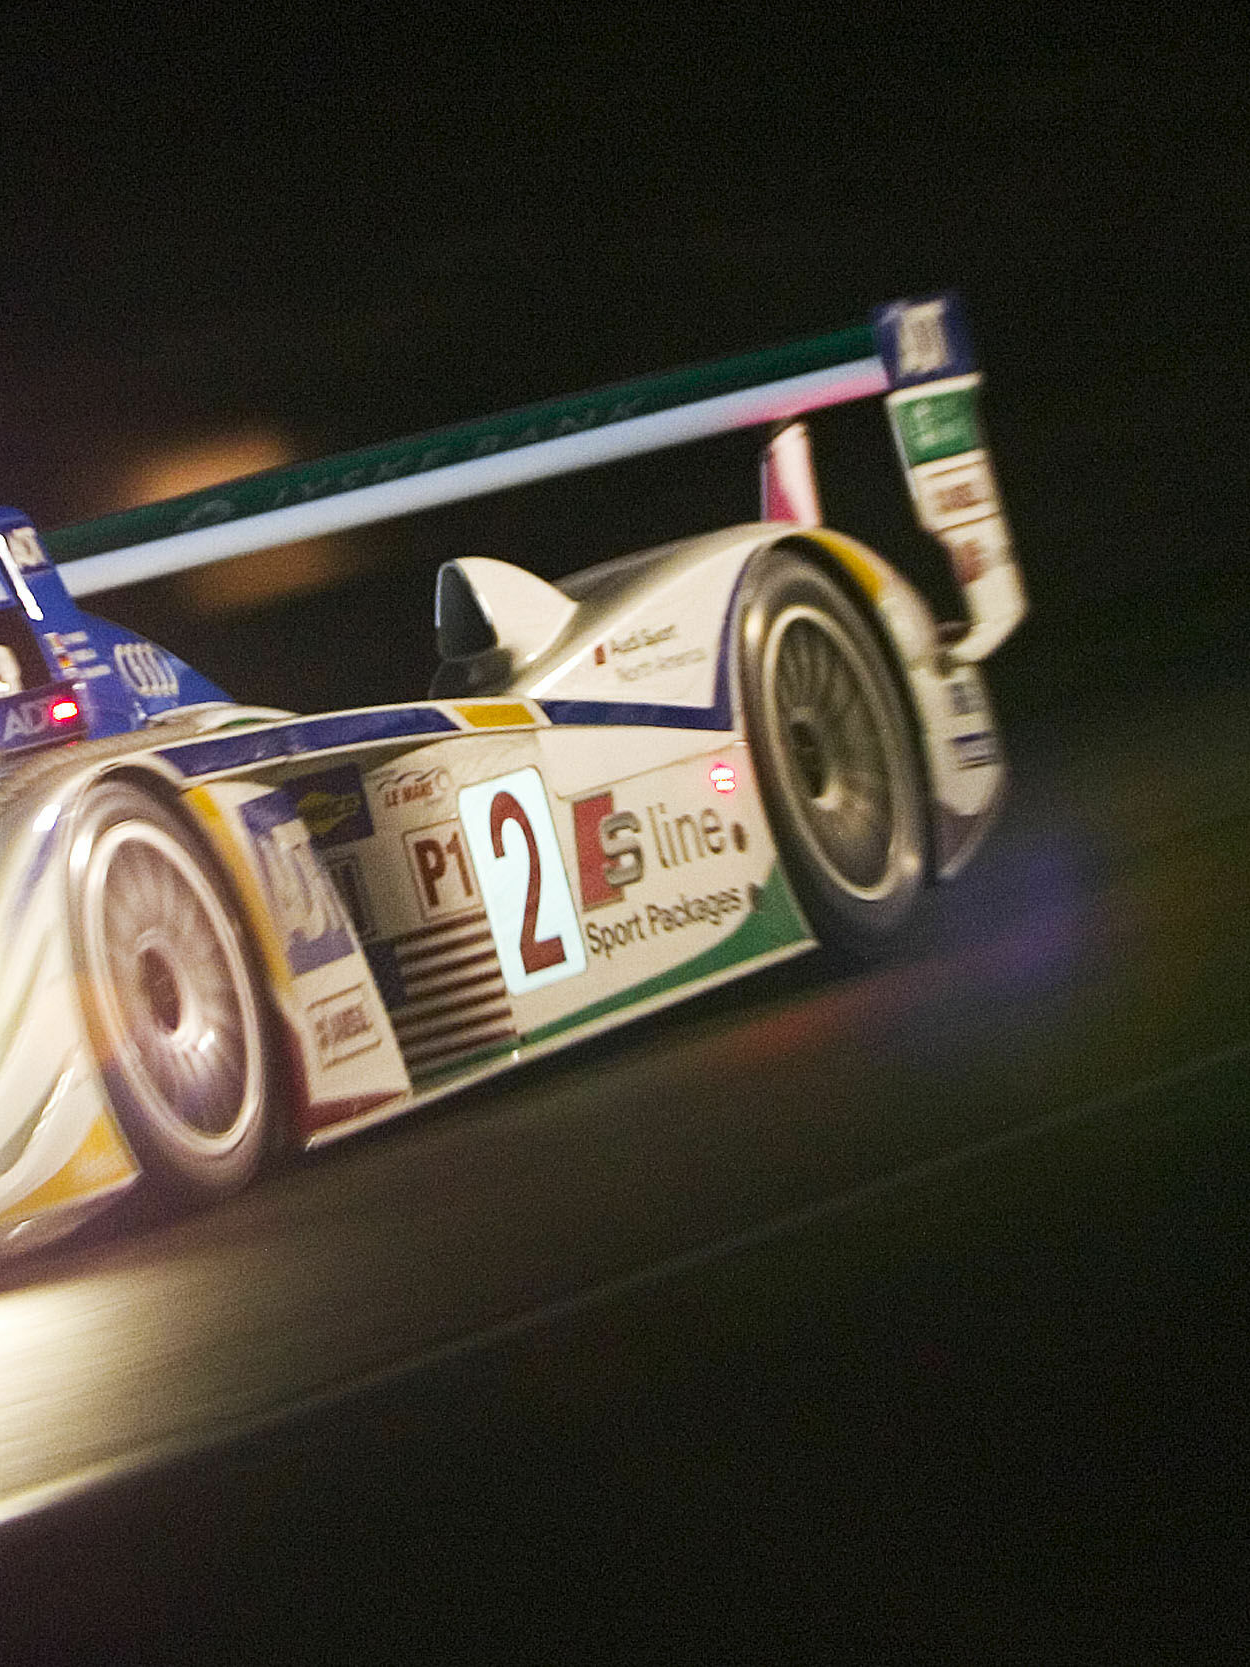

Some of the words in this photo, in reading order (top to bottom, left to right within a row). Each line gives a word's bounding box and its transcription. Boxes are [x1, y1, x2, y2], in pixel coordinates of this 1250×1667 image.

[414, 832, 473, 907] P1
[488, 790, 566, 976] 2
[601, 811, 644, 889] S
[646, 801, 726, 868] line
[586, 914, 646, 959] Sport
[646, 887, 742, 935] Packages
